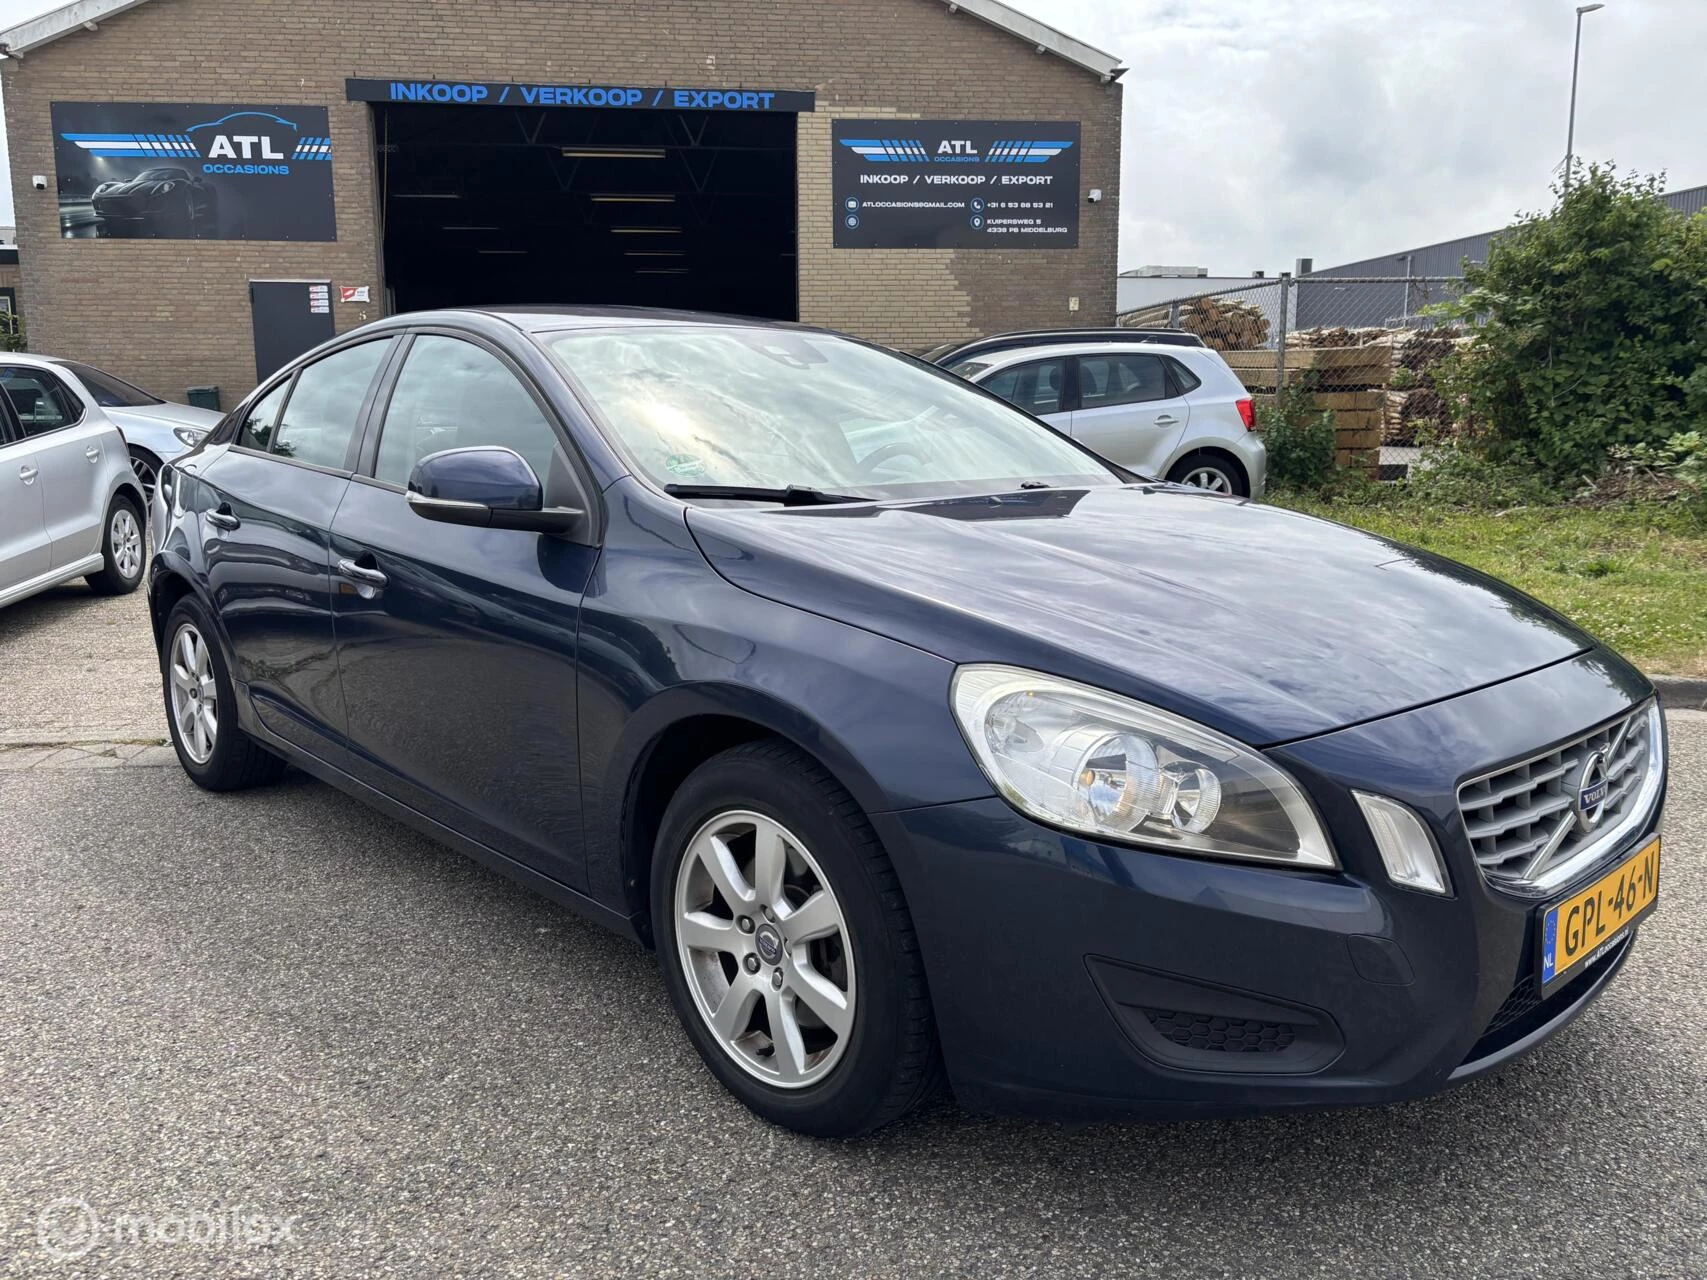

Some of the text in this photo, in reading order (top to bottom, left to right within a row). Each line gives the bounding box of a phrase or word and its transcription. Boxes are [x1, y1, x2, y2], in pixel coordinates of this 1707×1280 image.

[390, 82, 776, 109] INKOOP / VERKOOP / EXPORT
[208, 135, 284, 160] ATL
[937, 140, 978, 154] ATL
[202, 164, 290, 175] OCCASIONS
[860, 175, 1053, 185] INKOOP / VERKOOP / EXPORT
[1564, 851, 1656, 957] GPL-46-N
[1543, 953, 1554, 969] NL
